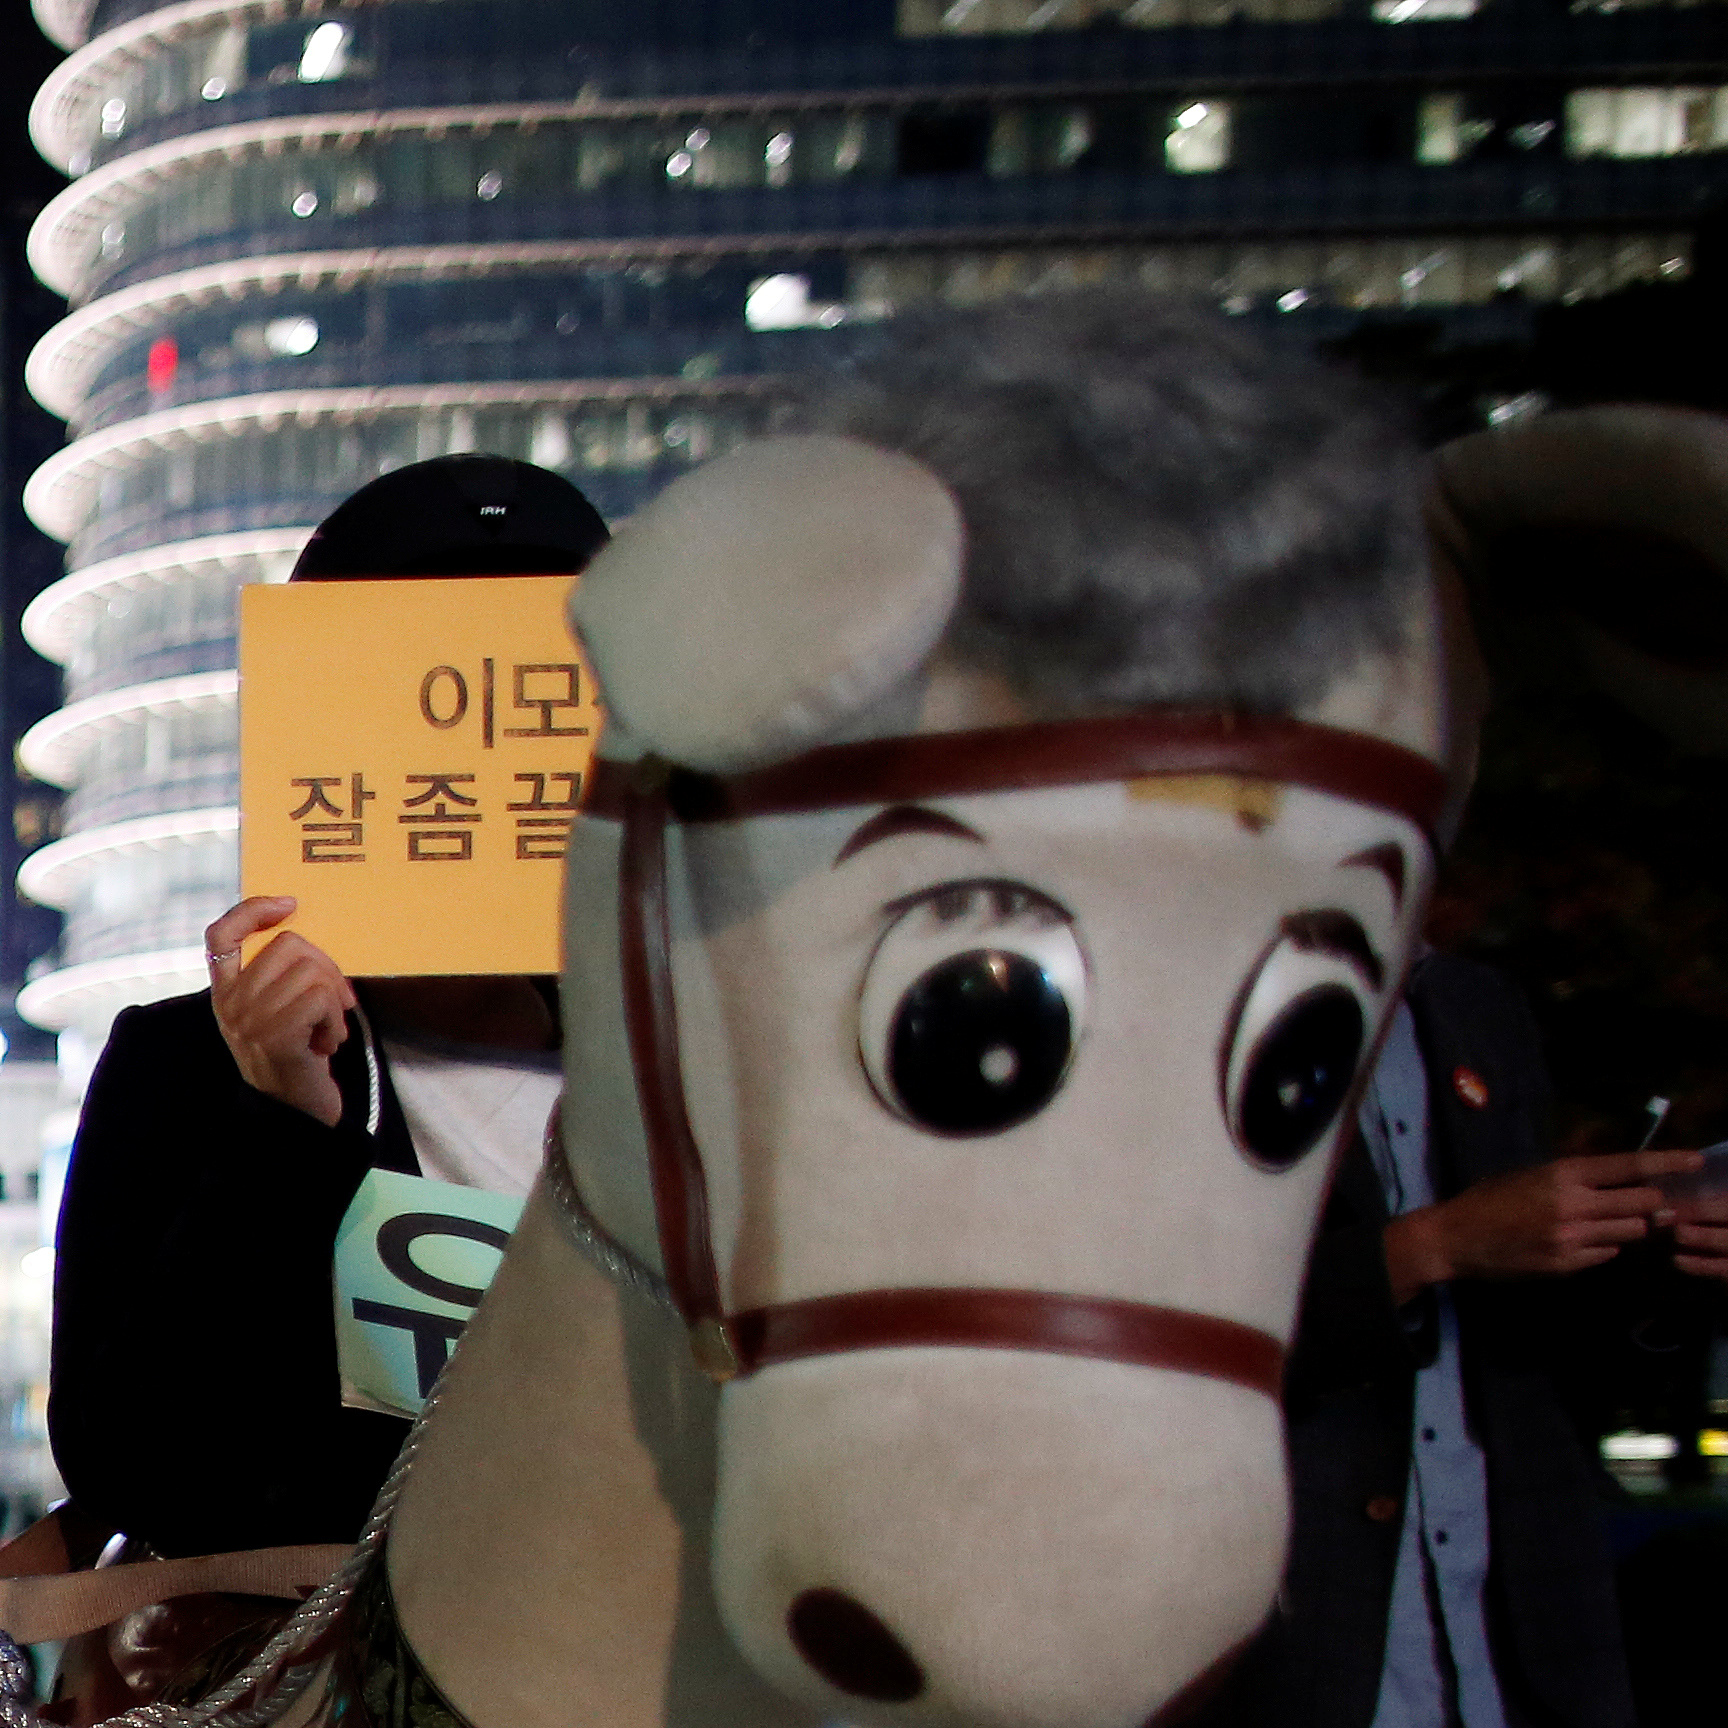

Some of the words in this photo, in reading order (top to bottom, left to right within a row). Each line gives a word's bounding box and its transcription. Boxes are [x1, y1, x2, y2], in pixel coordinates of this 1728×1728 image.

[418, 658, 589, 749] 이모
[289, 773, 375, 863] 잘
[398, 773, 482, 862] 좀
